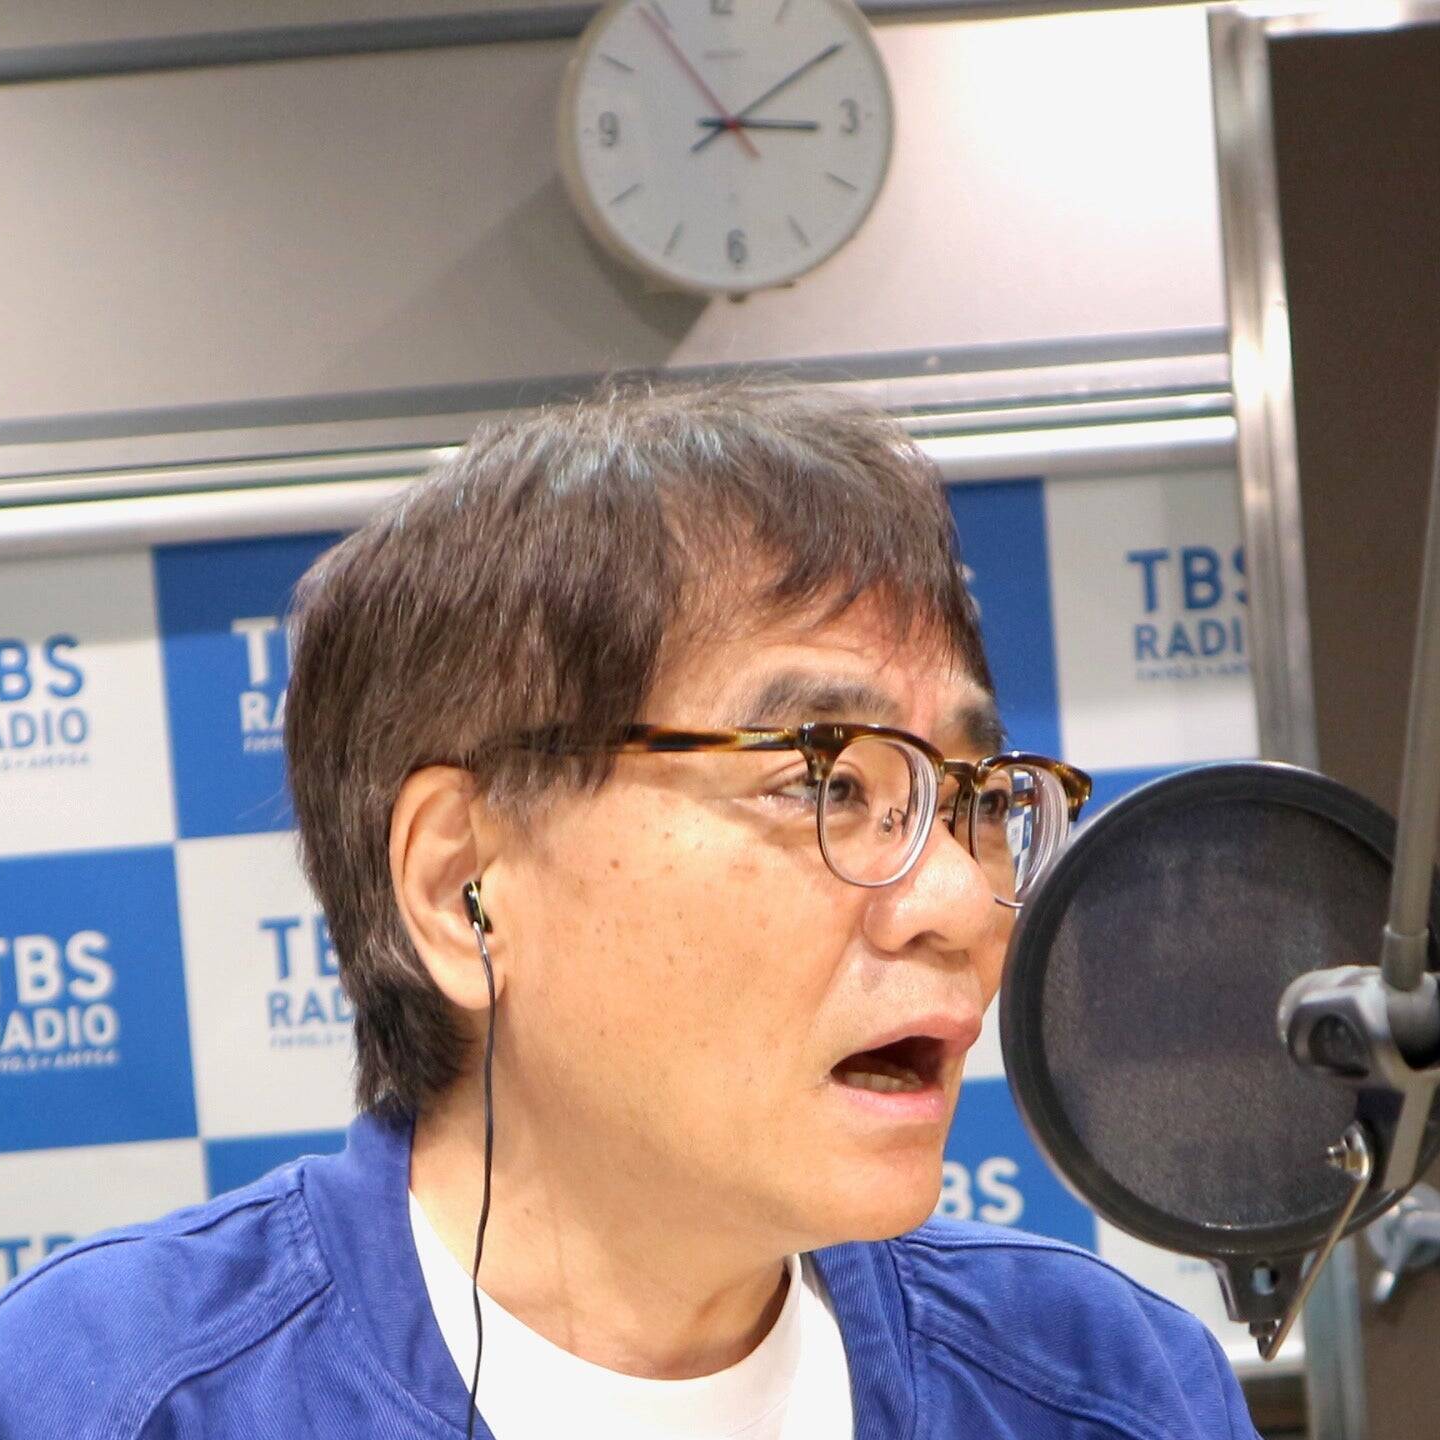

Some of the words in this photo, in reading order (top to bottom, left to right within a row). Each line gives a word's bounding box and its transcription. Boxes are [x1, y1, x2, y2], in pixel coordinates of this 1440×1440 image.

[598, 110, 620, 148] 9
[840, 98, 859, 136] 3
[726, 228, 747, 265] 6
[1126, 546, 1248, 613] TB
[1134, 616, 1244, 660] RADI
[940, 1157, 1023, 1224] BS
